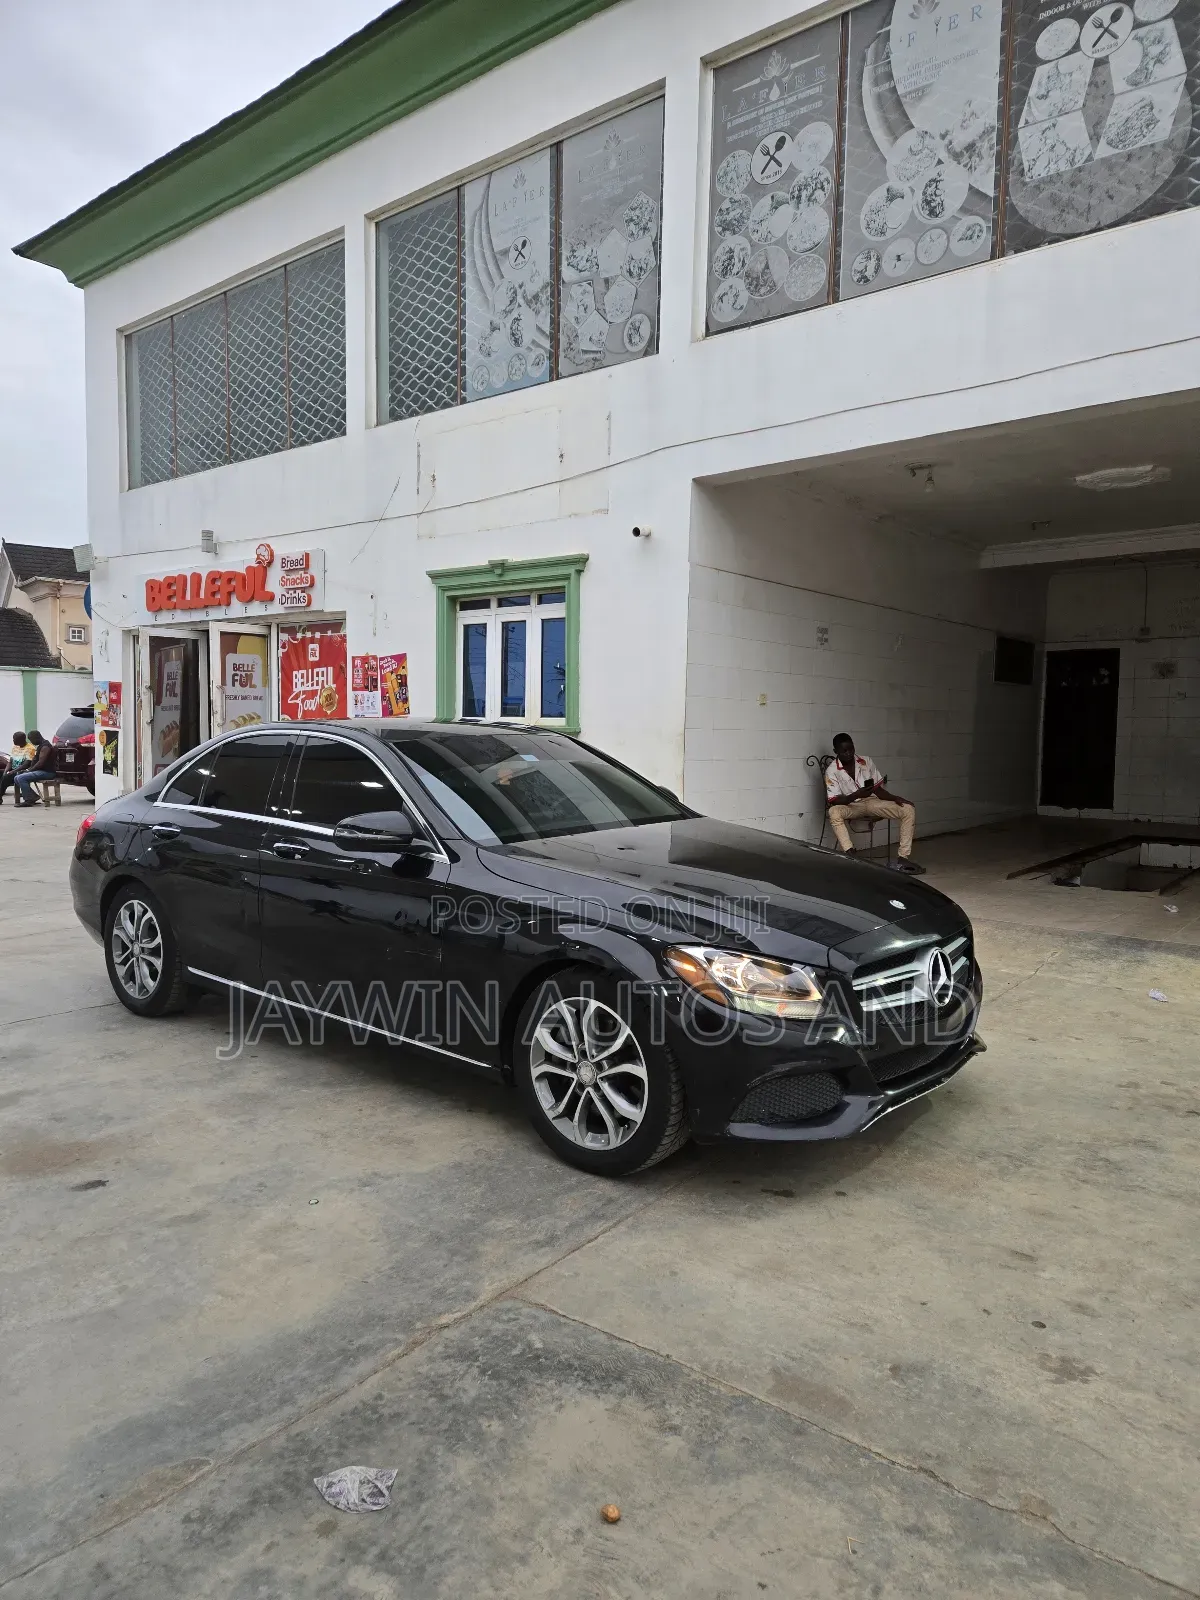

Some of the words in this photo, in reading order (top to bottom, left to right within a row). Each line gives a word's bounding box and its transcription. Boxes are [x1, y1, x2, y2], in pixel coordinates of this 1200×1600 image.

[281, 554, 304, 569] Bread
[280, 573, 310, 588] Snacks
[145, 565, 276, 612] BELLEFUL
[280, 592, 307, 606] Drinks
[232, 663, 256, 673] BELLE
[231, 672, 258, 689] FUL
[292, 666, 337, 692] BELLEFUL
